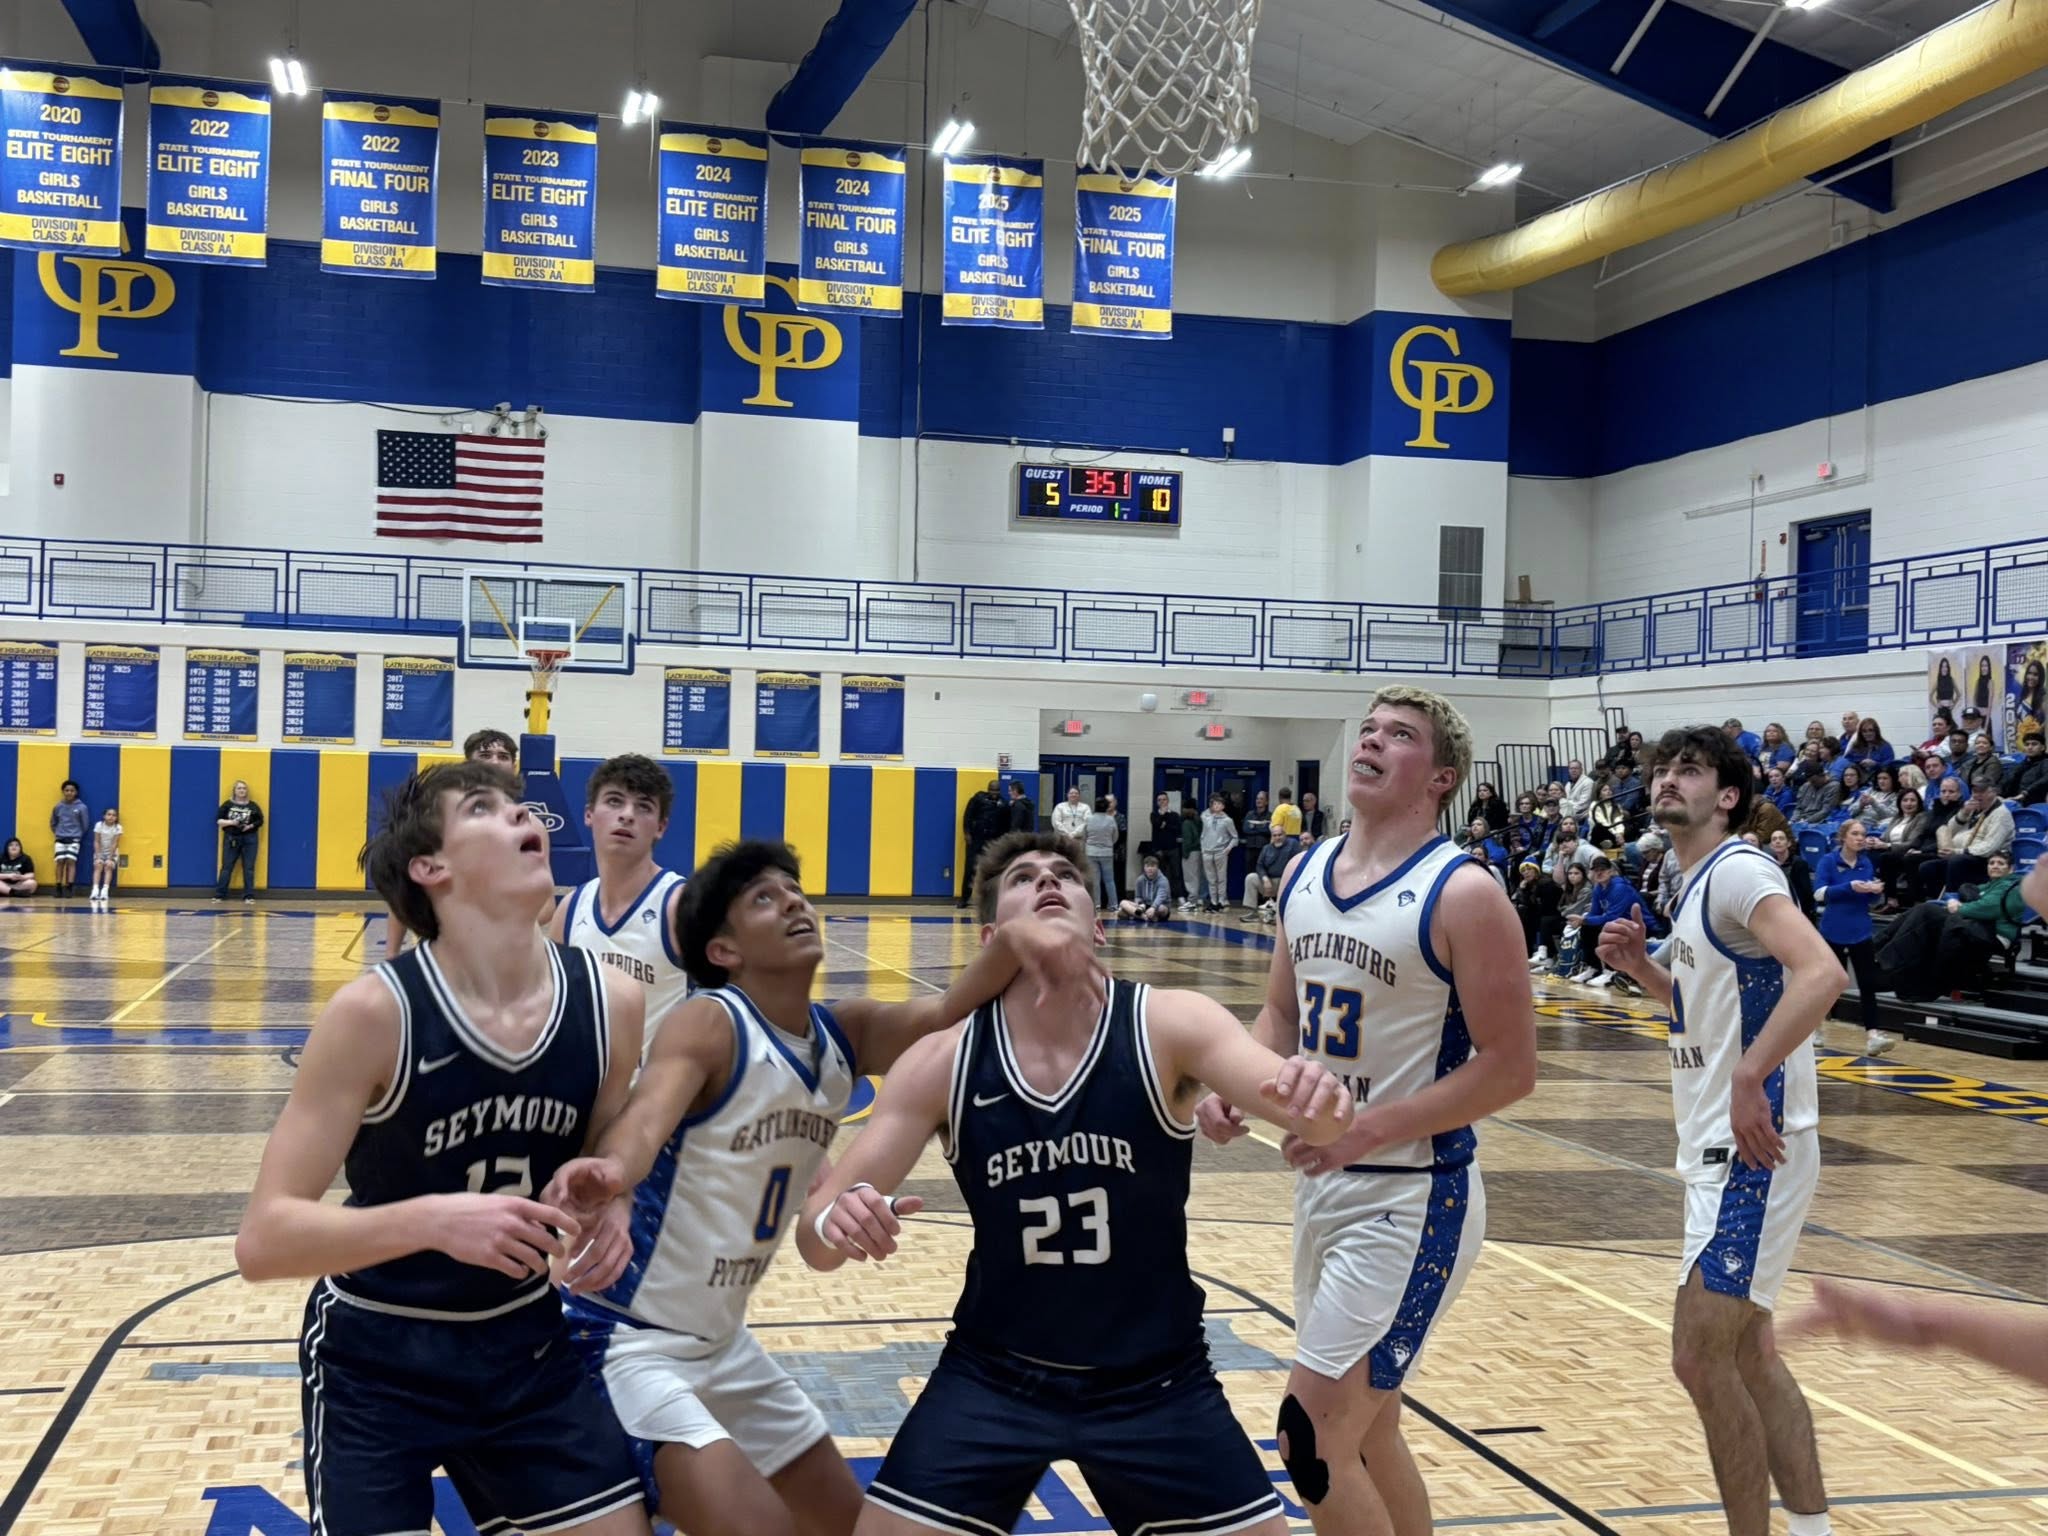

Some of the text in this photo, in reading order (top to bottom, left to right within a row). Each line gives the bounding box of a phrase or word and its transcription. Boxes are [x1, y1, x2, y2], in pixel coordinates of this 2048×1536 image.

[40, 104, 81, 124] 2020
[190, 119, 229, 137] 2022
[7, 129, 112, 146] STATE TOURNAMENT
[362, 135, 399, 152] 2022
[7, 140, 113, 166] ELITE EIGHT
[159, 143, 260, 159] STATE TOURNAMENT
[523, 149, 559, 167] 2023
[157, 155, 260, 179] ELITE EIGHT
[331, 159, 429, 173] STATE TOURNAMENT
[696, 165, 731, 183] 2024
[39, 172, 80, 188] GIRLS
[330, 170, 429, 193] FINAL FOUR
[493, 173, 587, 187] STATE TOURNAMENT
[836, 178, 870, 196] 2024
[17, 190, 102, 209] BASKETBALL
[189, 185, 228, 200] GIRLS
[492, 184, 587, 206] ELITE EIGHT
[667, 187, 758, 203] STATE TOURNAMENT
[361, 199, 398, 214] GIRLS
[666, 198, 758, 222] ELITE EIGHT
[808, 201, 896, 216] STATE TOURNAMENT
[978, 194, 1008, 211] 2025
[167, 202, 248, 220] BASKETBALL
[1109, 206, 1141, 222] 2025
[32, 218, 88, 231] DIVISION 1
[340, 216, 418, 234] BASKETBALL
[521, 213, 557, 227] GIRLS
[807, 212, 896, 235] FINAL FOUR
[953, 216, 1035, 229] STATE TOURNAMENT
[33, 230, 85, 242] CLASS AA
[180, 230, 234, 243] DIVISION 1
[501, 230, 577, 247] BASKETBALL
[694, 228, 729, 243] GIRLS
[952, 226, 1035, 247] ELITE EIGHT
[1083, 228, 1166, 241] STATE TOURNAMENT
[181, 241, 231, 254] CLASS AA
[353, 244, 405, 256] DIVISION 1
[675, 244, 748, 262] BASKETBALL
[834, 241, 868, 255] GIRLS
[1083, 239, 1165, 259] FINAL FOUR
[354, 255, 403, 267] CLASS AA
[514, 257, 564, 269] DIVISION 1
[816, 257, 886, 274] BASKETBALL
[978, 254, 1008, 269] GIRLS
[514, 268, 562, 280] CLASS AA
[687, 271, 735, 283] DIVISION 1
[960, 271, 1026, 288] BASKETBALL
[1108, 265, 1139, 279] GIRLS
[688, 282, 733, 294] CLASS AA
[827, 283, 874, 295] DIVISION 1
[1089, 281, 1155, 298] BASKETBALL
[828, 294, 872, 306] CLASS AA
[972, 296, 1015, 308] DIVISION 1
[972, 307, 1014, 318] CLASS AA
[1100, 307, 1136, 318] DIVISION
[1101, 317, 1142, 329] CLASS AA
[1025, 469, 1064, 479] GUEST
[1139, 475, 1172, 485] HOME
[1085, 470, 1129, 495] 3:51
[1046, 483, 1059, 505] 5
[1152, 489, 1170, 511] 10
[1070, 504, 1103, 512] PERIOD
[1114, 502, 1120, 518] 1
[386, 702, 403, 710] 2025
[1290, 932, 1397, 987] ATLINBURG
[1301, 979, 1365, 1062] 33
[424, 1095, 578, 1158] SEYMOUR
[728, 1108, 839, 1152] GATLINBUR
[987, 1132, 1136, 1188] SEYMOUR
[754, 1164, 793, 1242] 0
[1019, 1187, 1111, 1265] 23
